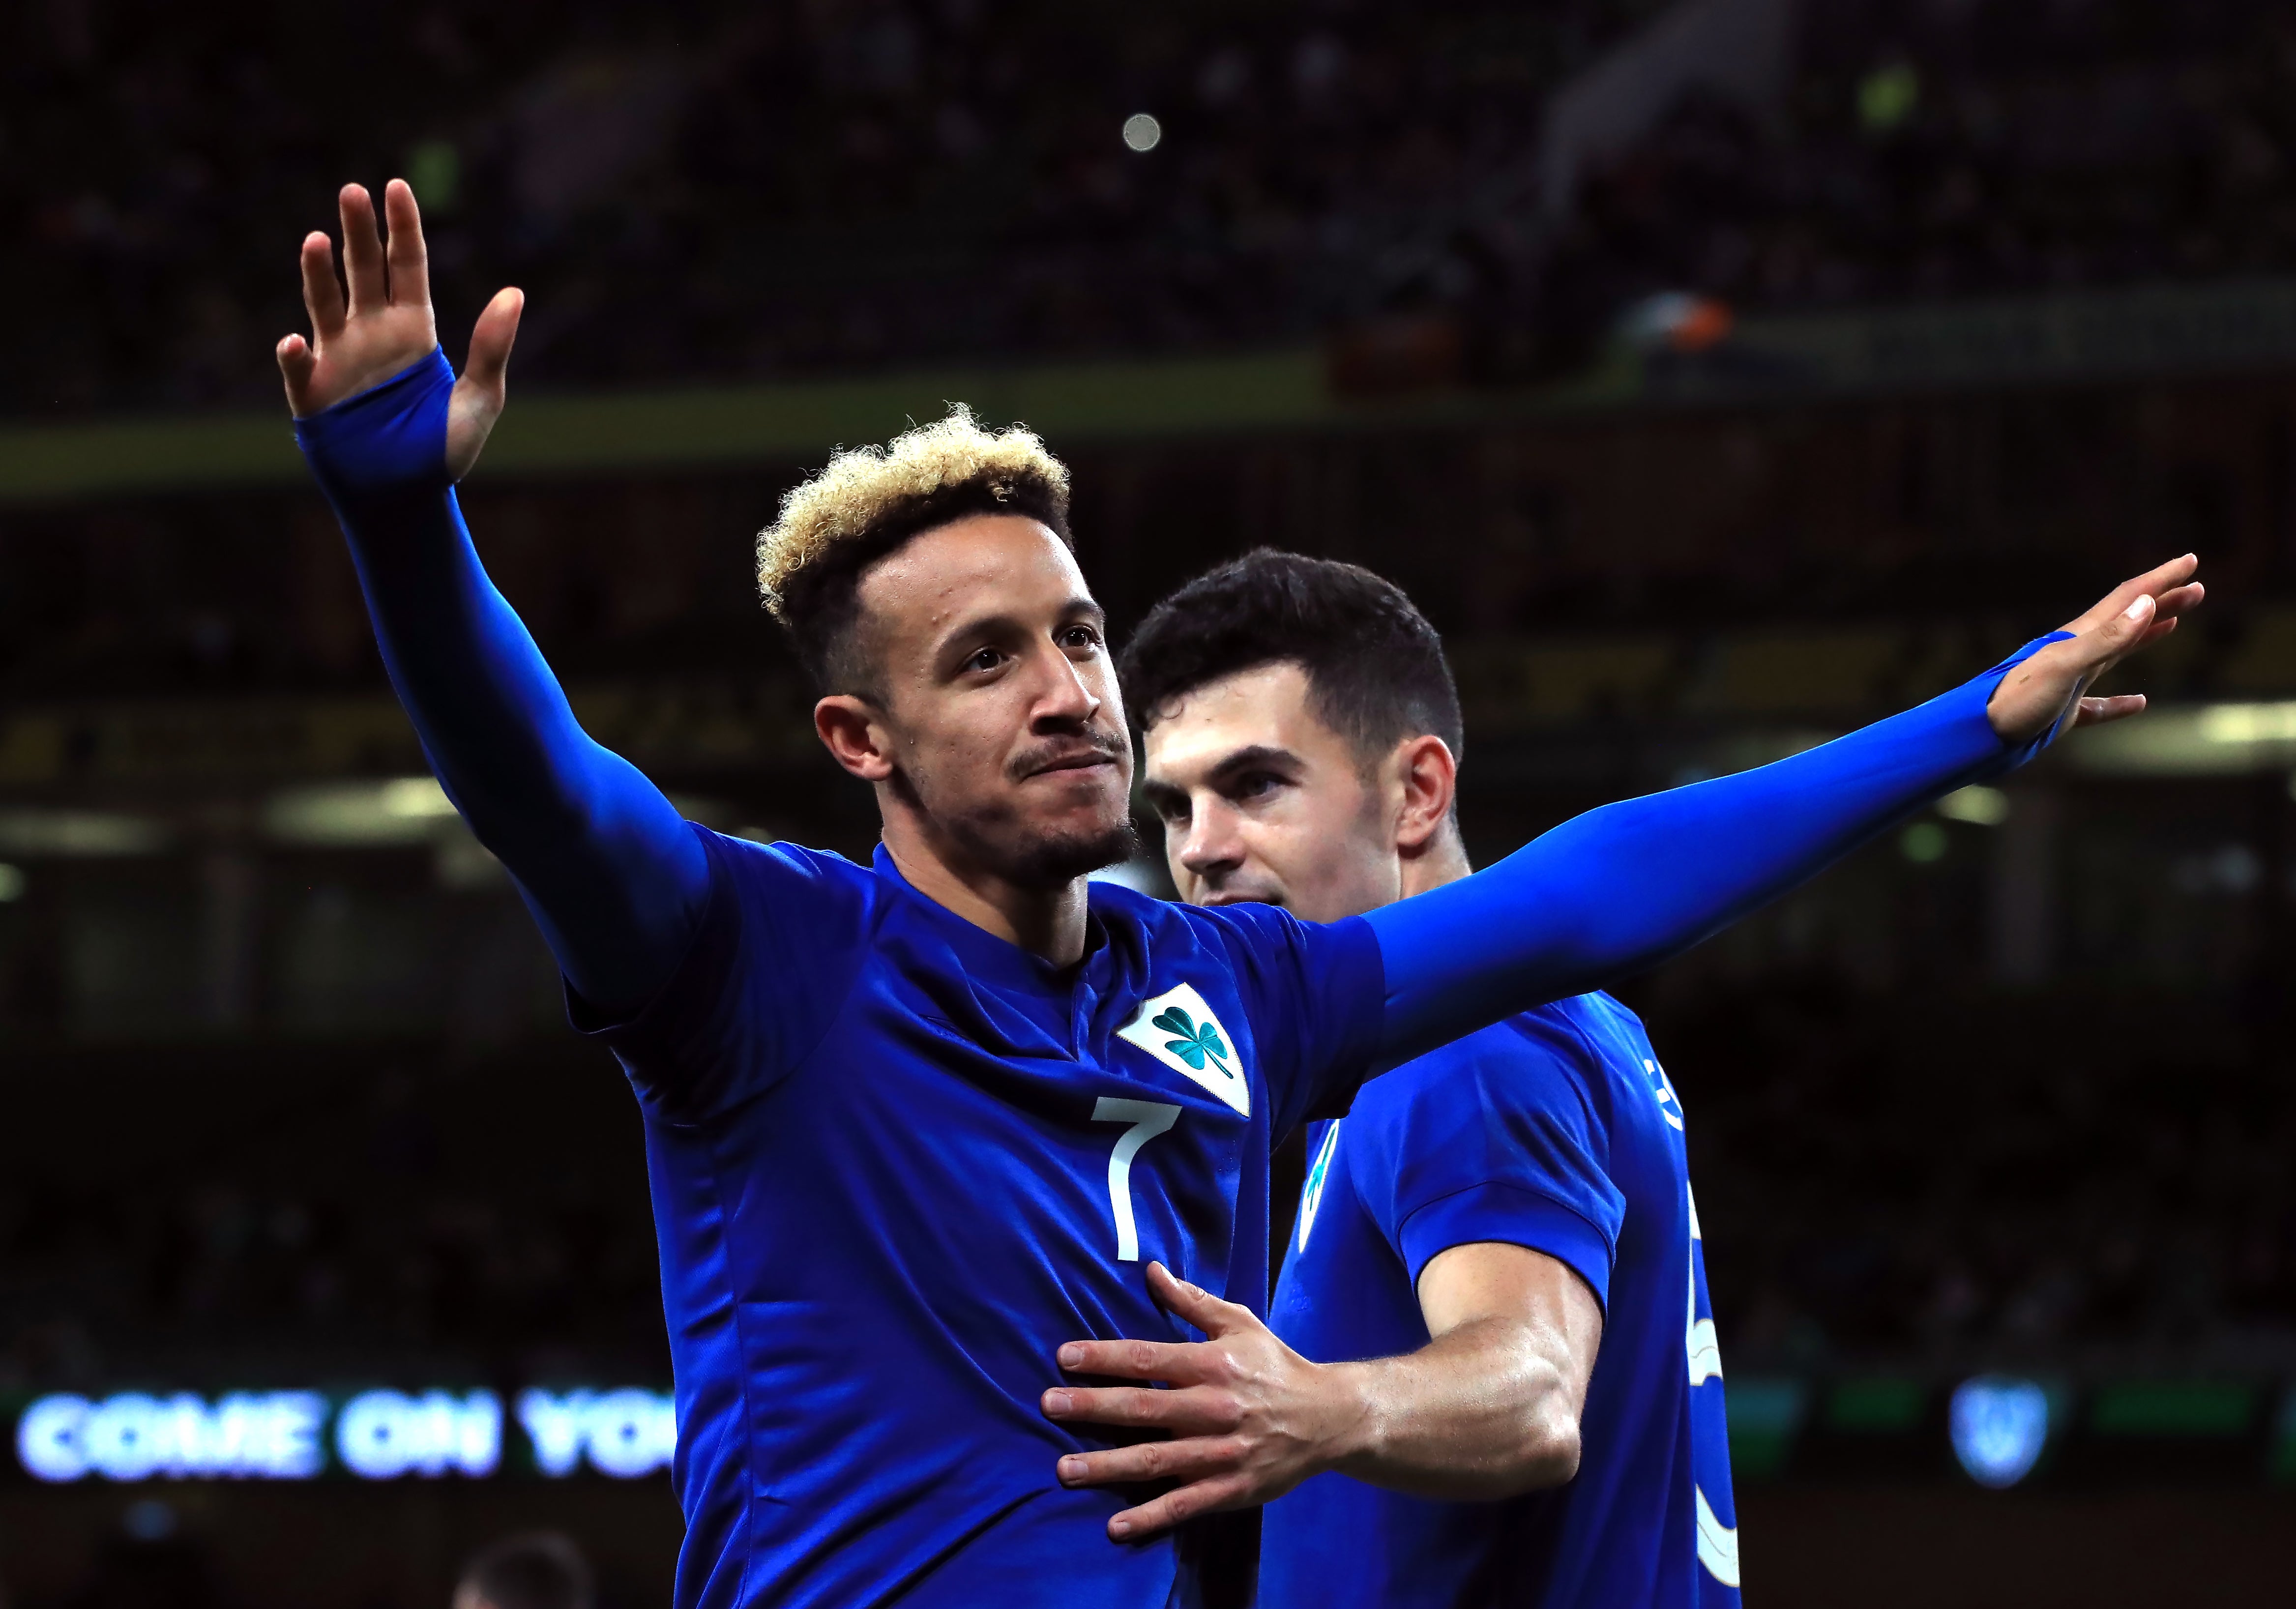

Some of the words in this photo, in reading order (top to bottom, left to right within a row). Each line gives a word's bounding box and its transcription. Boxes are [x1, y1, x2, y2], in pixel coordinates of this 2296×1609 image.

[1091, 1097, 1182, 1261] 7
[18, 1391, 326, 1479] COME
[335, 1390, 502, 1477] ON
[516, 1388, 677, 1477] YO
